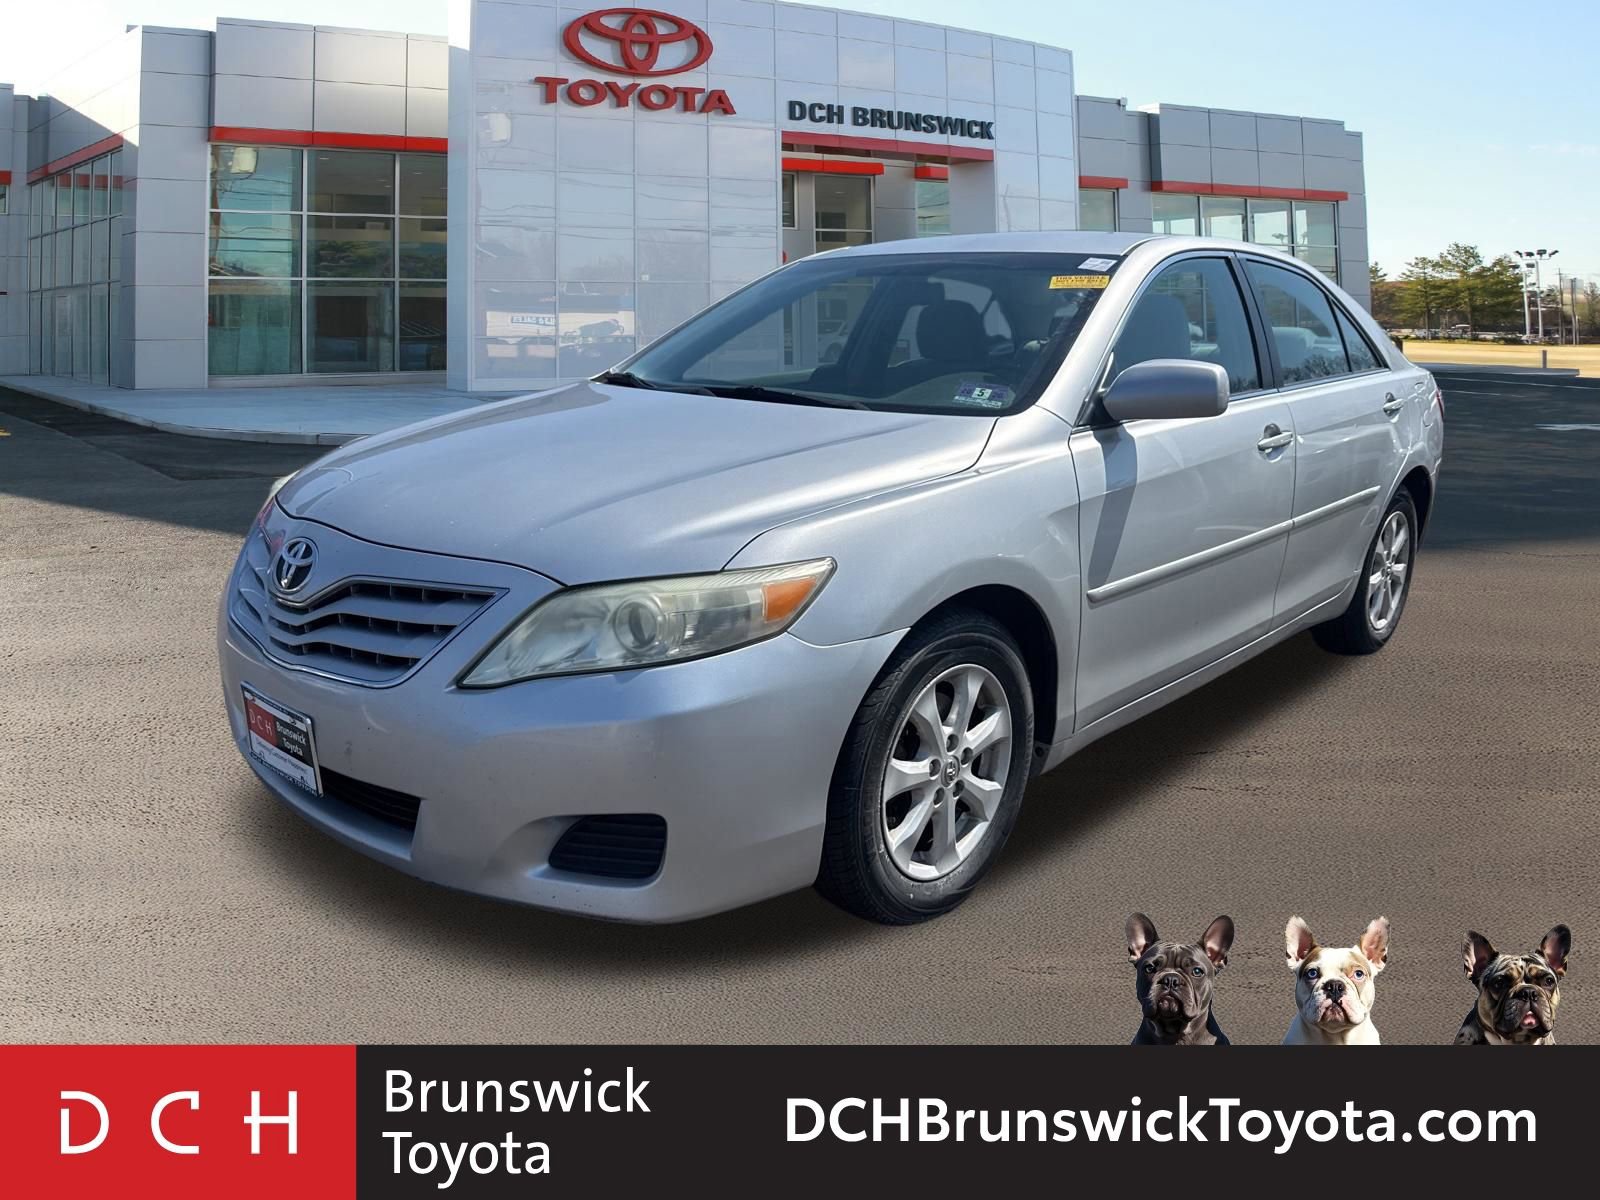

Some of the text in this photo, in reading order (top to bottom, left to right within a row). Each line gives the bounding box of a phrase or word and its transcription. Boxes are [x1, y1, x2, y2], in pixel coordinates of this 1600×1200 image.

[534, 76, 737, 115] TOYOTA
[788, 100, 995, 140] DCH BRUNSWICK
[282, 737, 303, 756] Toyota
